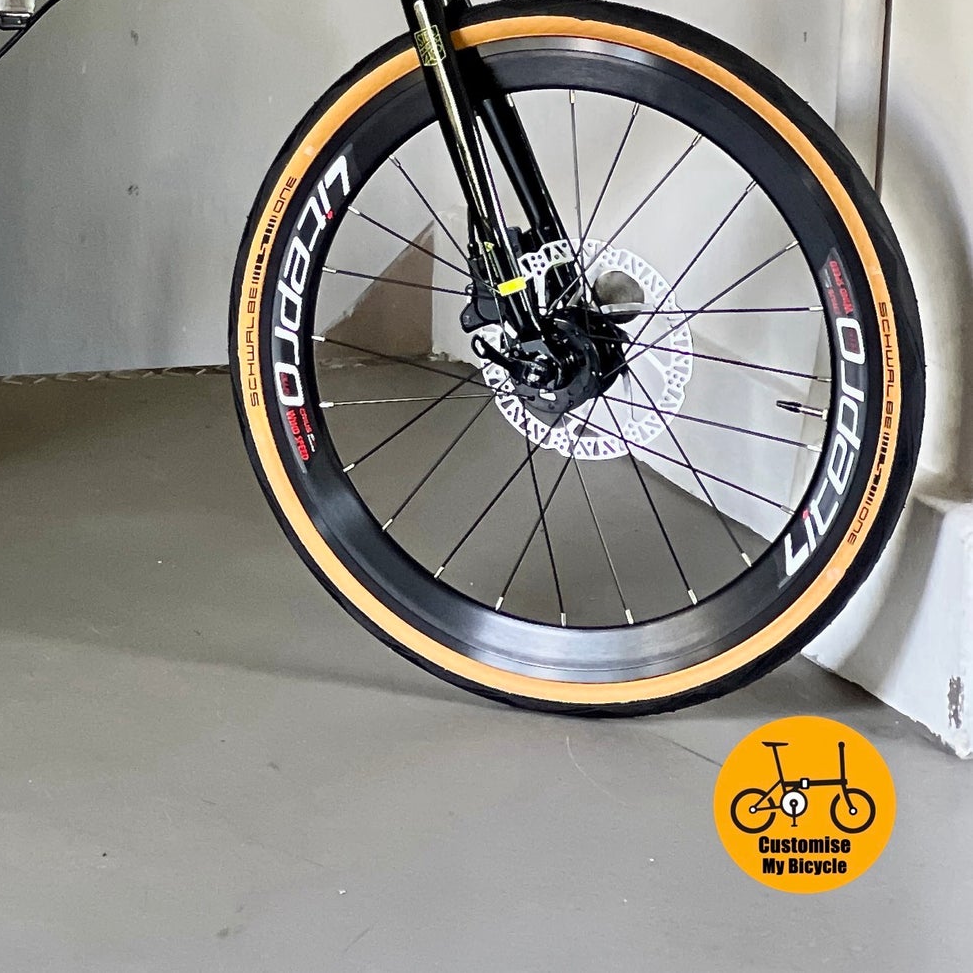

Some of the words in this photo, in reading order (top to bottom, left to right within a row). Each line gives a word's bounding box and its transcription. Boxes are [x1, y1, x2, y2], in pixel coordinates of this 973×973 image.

[246, 287, 260, 407] SCHWALBE
[274, 175, 298, 215] ONE
[878, 301, 893, 430] SCHWALBE
[846, 506, 870, 546] ONE
